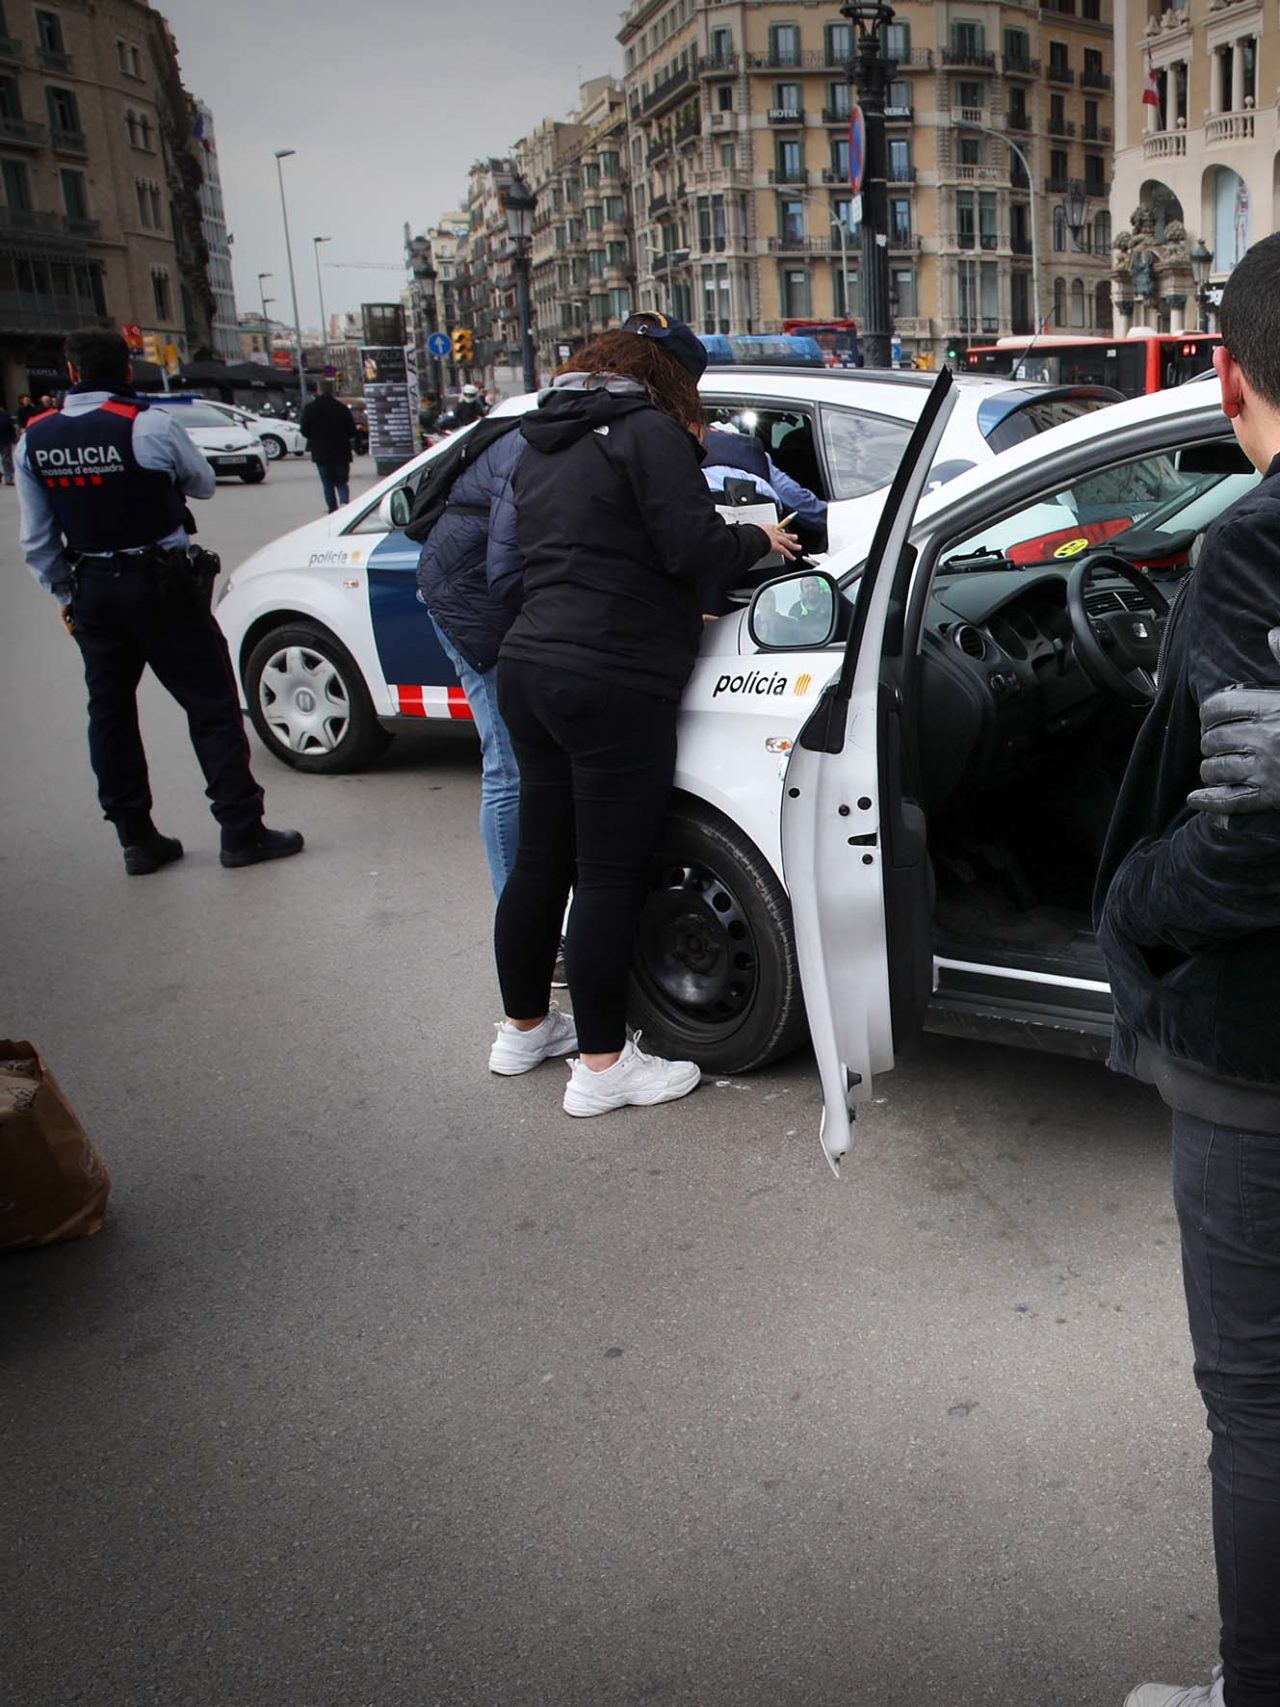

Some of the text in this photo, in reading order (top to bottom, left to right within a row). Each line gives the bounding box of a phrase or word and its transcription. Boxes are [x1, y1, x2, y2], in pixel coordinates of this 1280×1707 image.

[769, 109, 799, 118] HOTEL
[35, 445, 122, 467] POLICIA
[41, 467, 73, 476] mossos
[309, 550, 348, 567] policia
[712, 671, 788, 698] policia
